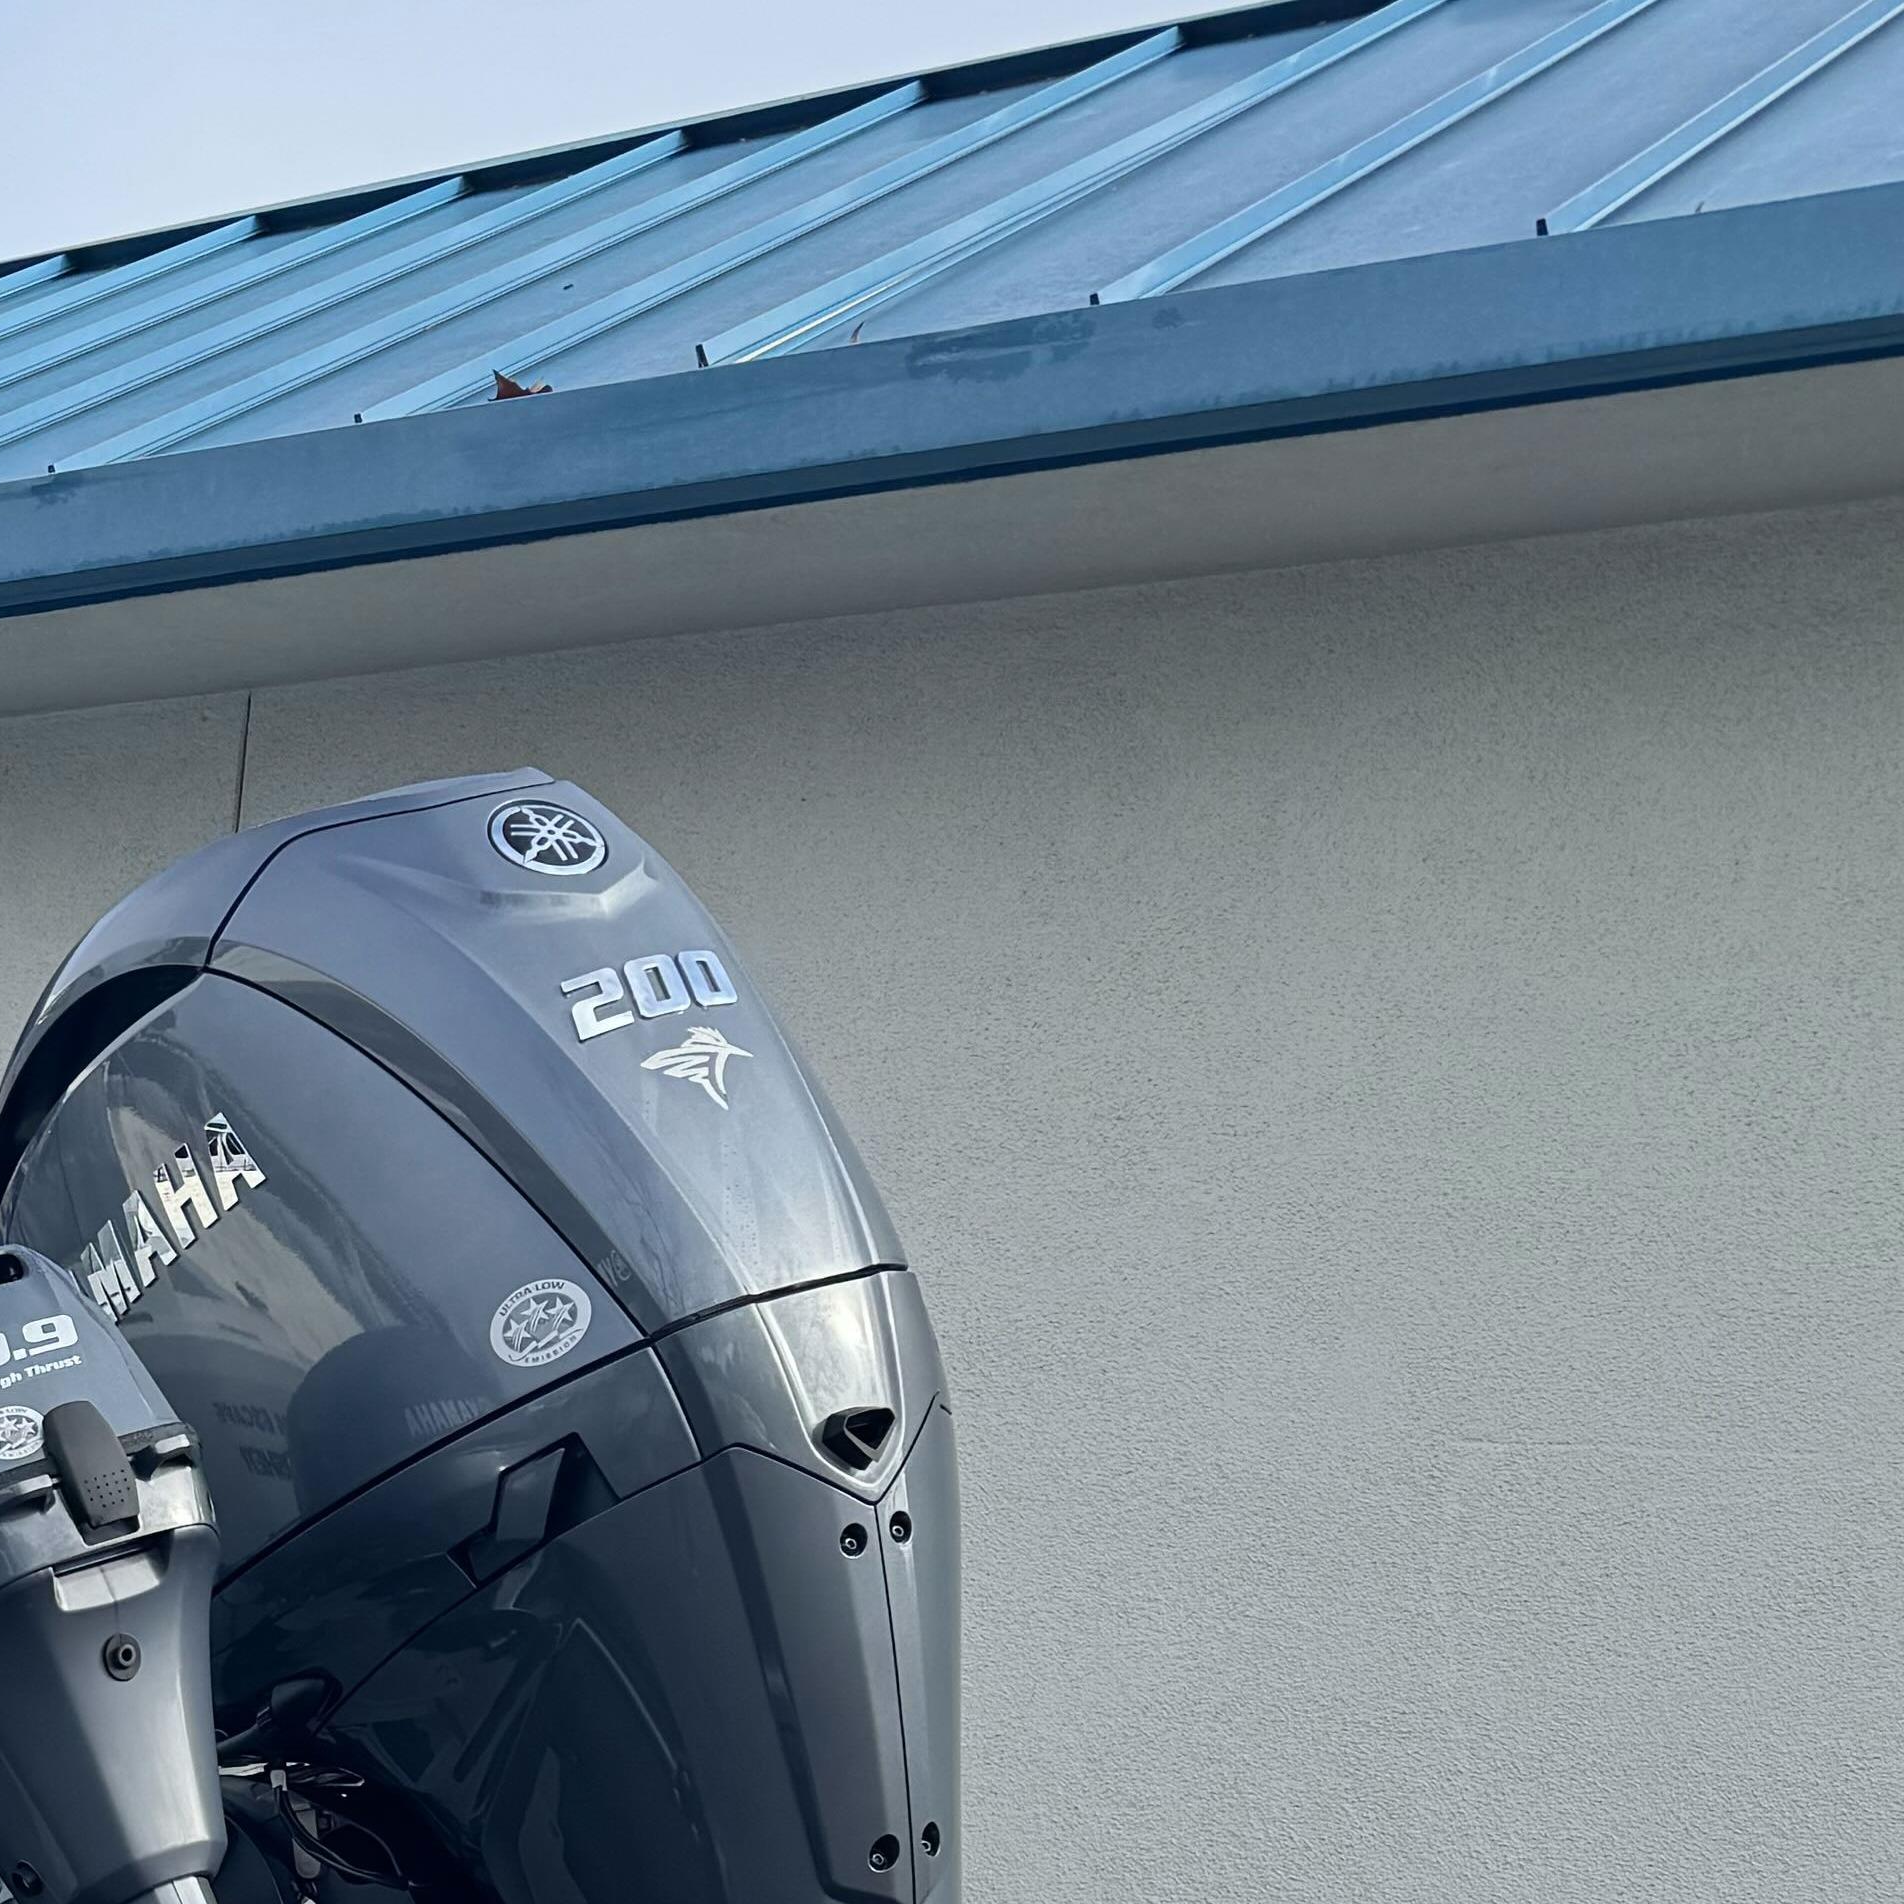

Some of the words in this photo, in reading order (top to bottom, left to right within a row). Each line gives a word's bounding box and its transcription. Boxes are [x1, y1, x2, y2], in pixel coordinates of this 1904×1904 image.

[560, 949, 738, 1043] 200
[76, 1112, 267, 1324] MAHA
[498, 1286, 533, 1318] ULTRA
[534, 1280, 566, 1292] LOW
[23, 1354, 83, 1378] Thrust
